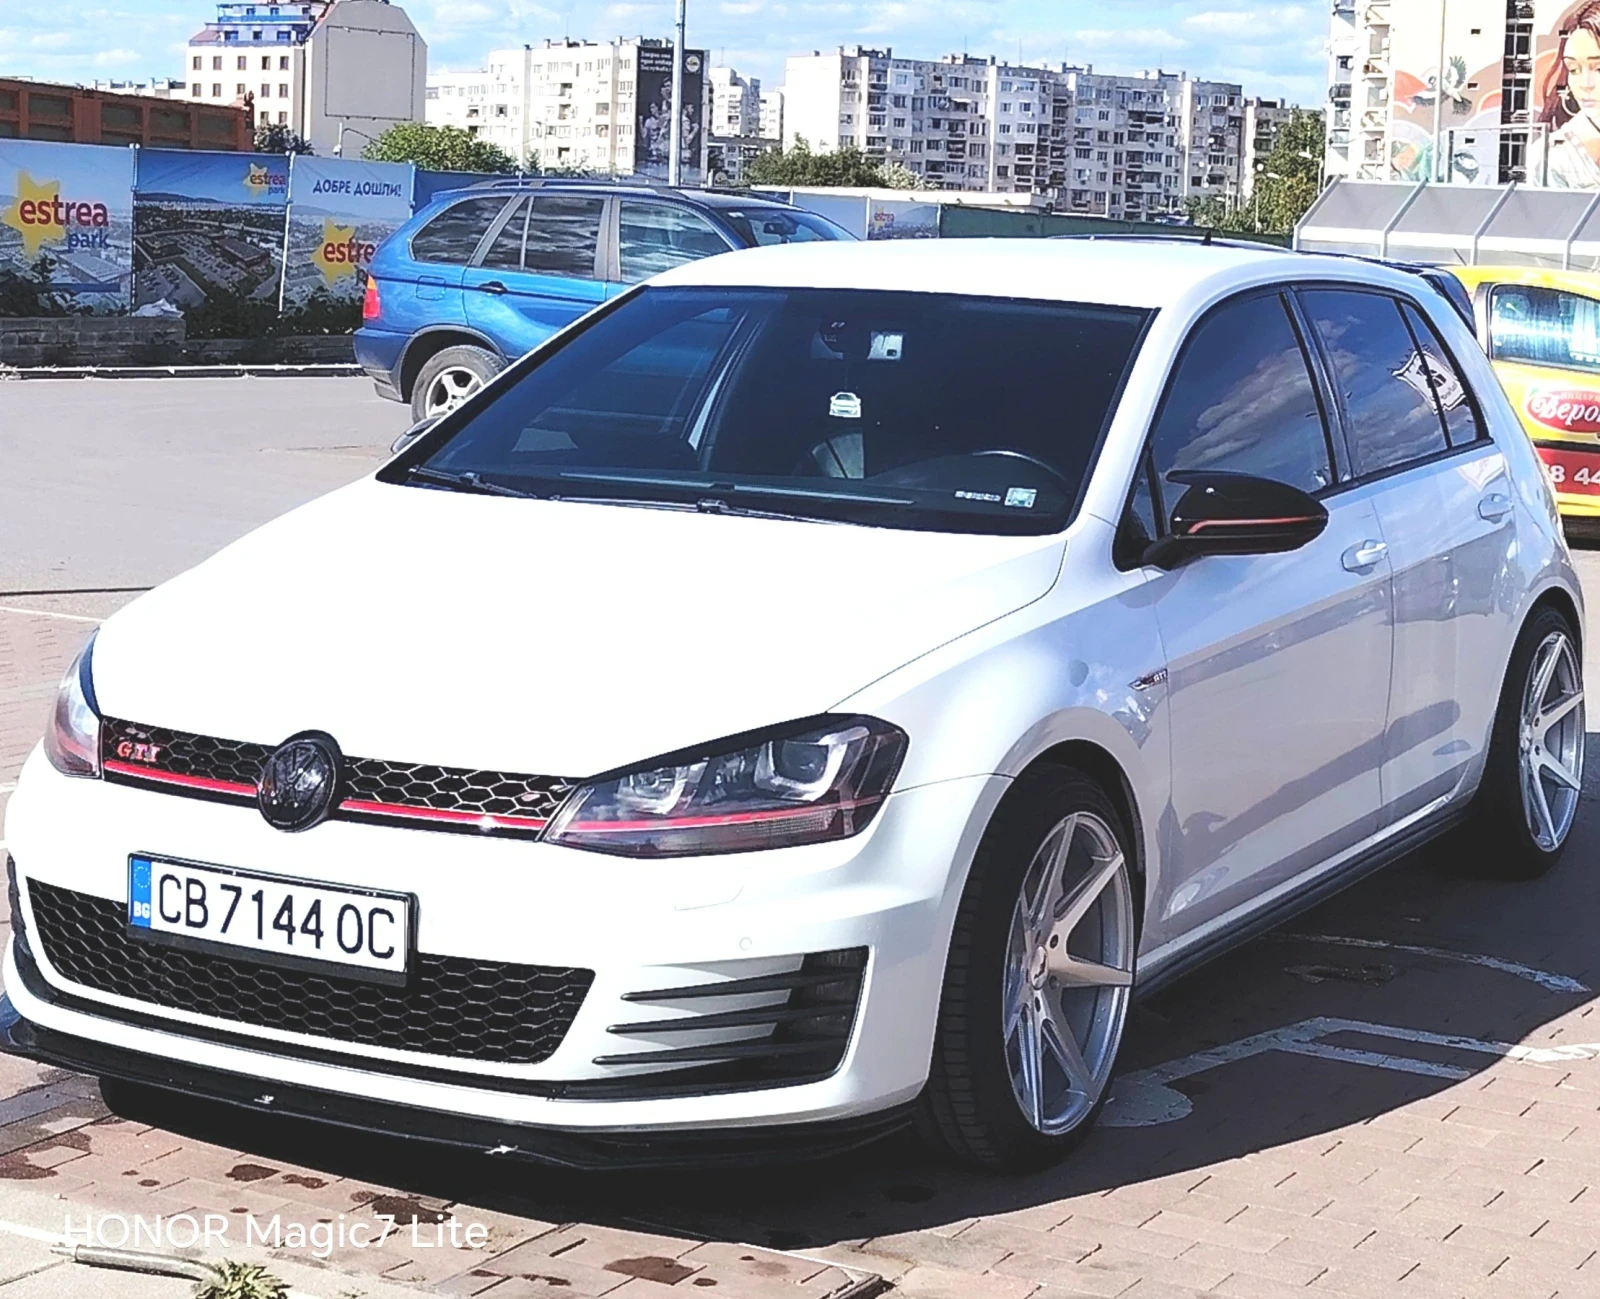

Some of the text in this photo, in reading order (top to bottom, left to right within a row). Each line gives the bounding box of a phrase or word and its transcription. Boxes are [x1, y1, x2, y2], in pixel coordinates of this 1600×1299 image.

[250, 172, 287, 186] estrea
[312, 179, 402, 197] ДОБРЕ ДОШЛИ!
[20, 194, 109, 227] estrea
[68, 228, 110, 253] park
[323, 235, 380, 264] estre
[1531, 396, 1600, 426] Веро
[1545, 464, 1566, 483] 8
[117, 741, 160, 762] GTI
[133, 901, 151, 919] BG
[159, 874, 209, 929] CB
[220, 883, 324, 950] 7144
